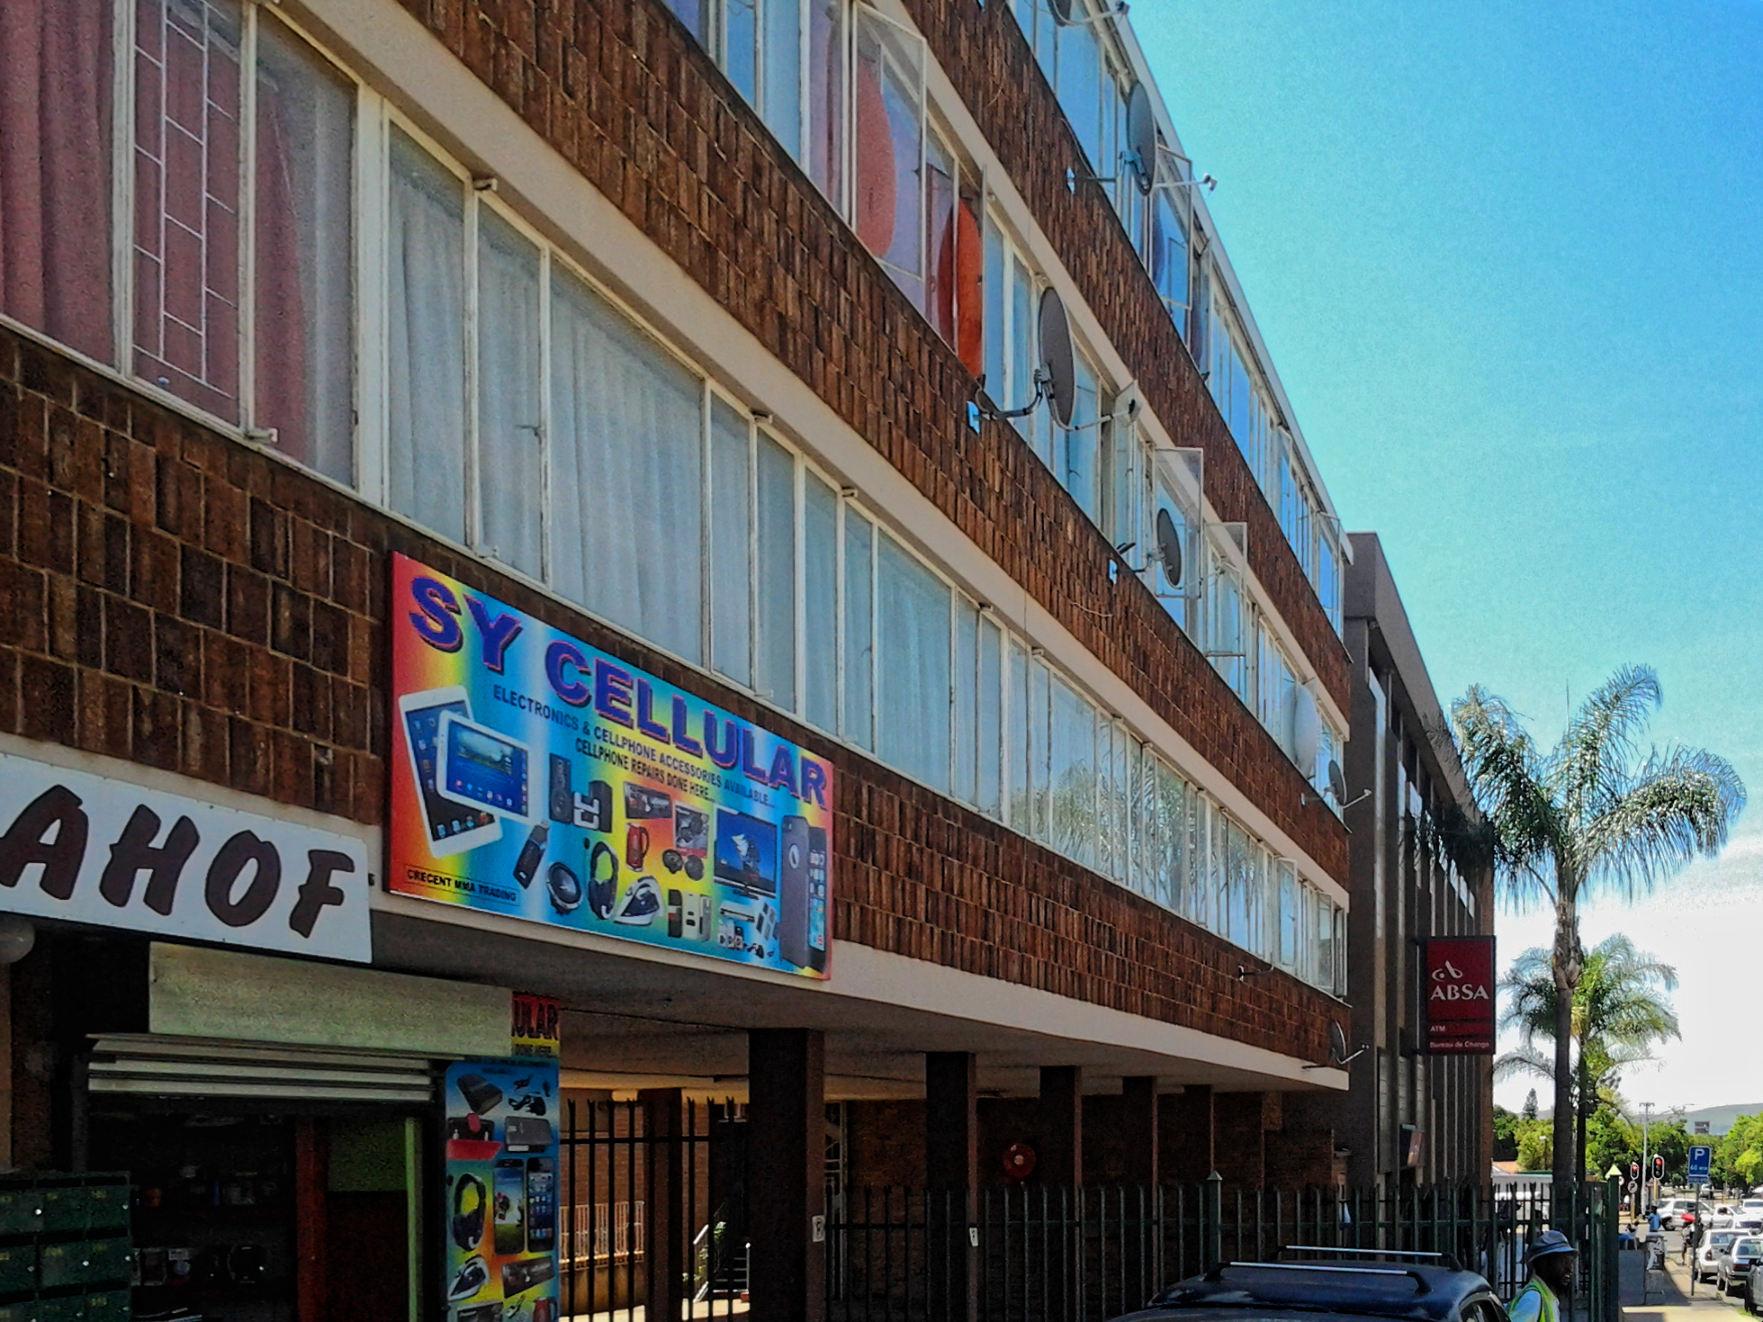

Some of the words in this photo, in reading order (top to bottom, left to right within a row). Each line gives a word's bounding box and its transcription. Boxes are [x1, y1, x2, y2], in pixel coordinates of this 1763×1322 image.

[409, 574, 522, 675] SY
[544, 639, 829, 811] CELLULAR
[493, 684, 579, 731] ELECTRONICS
[583, 721, 591, 736] &
[594, 726, 656, 761] CELLPHONE
[659, 752, 721, 788] ACCESSORIES
[576, 738, 628, 770] CELLPHONE
[631, 758, 665, 784] REPAIRS
[666, 772, 688, 792] DONE
[0, 784, 355, 938] AHOF
[406, 869, 451, 887] CRECENT
[478, 884, 517, 902] TRADING
[1430, 984, 1489, 1000] ABSA
[1464, 1041, 1490, 1049] Change
[1694, 1148, 1705, 1160] P
